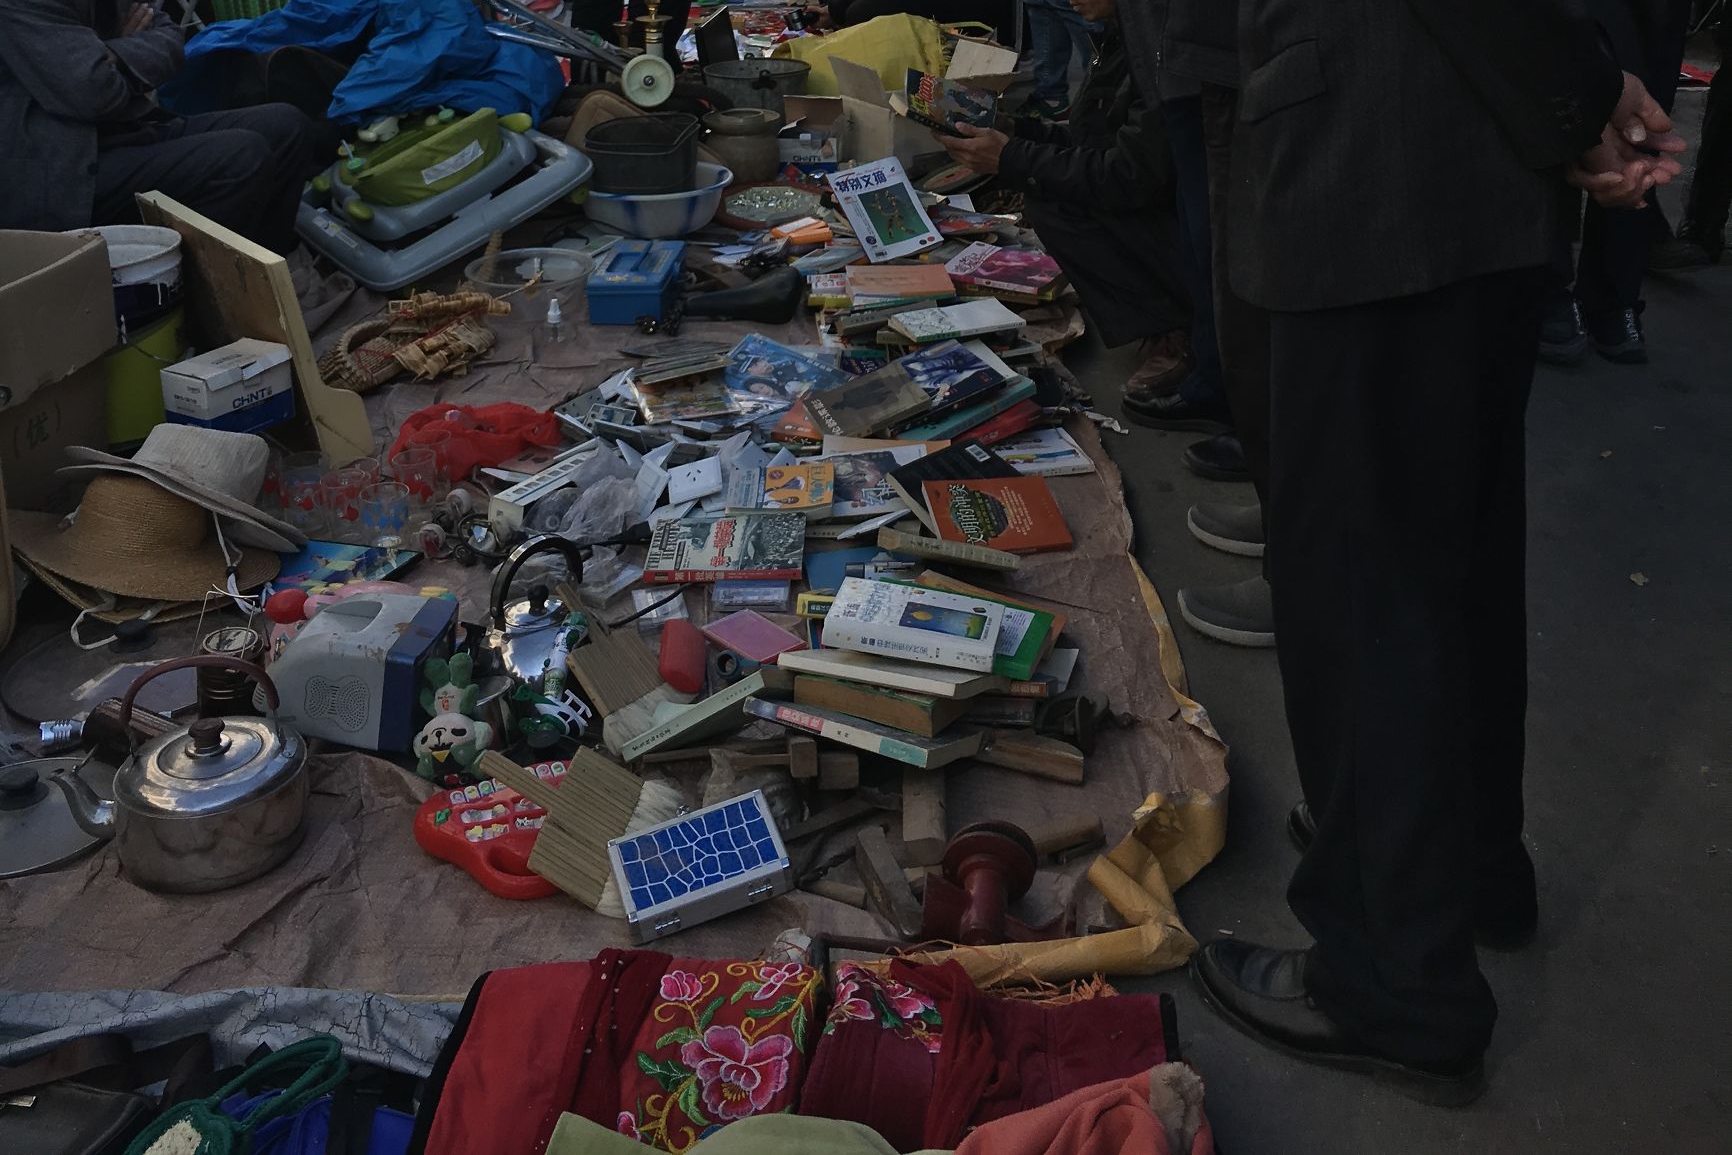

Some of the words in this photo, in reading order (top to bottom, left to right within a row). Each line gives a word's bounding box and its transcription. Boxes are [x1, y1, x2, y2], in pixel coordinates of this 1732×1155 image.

[834, 170, 887, 194] 特别文摘
[947, 482, 988, 545] 文明的冲突
